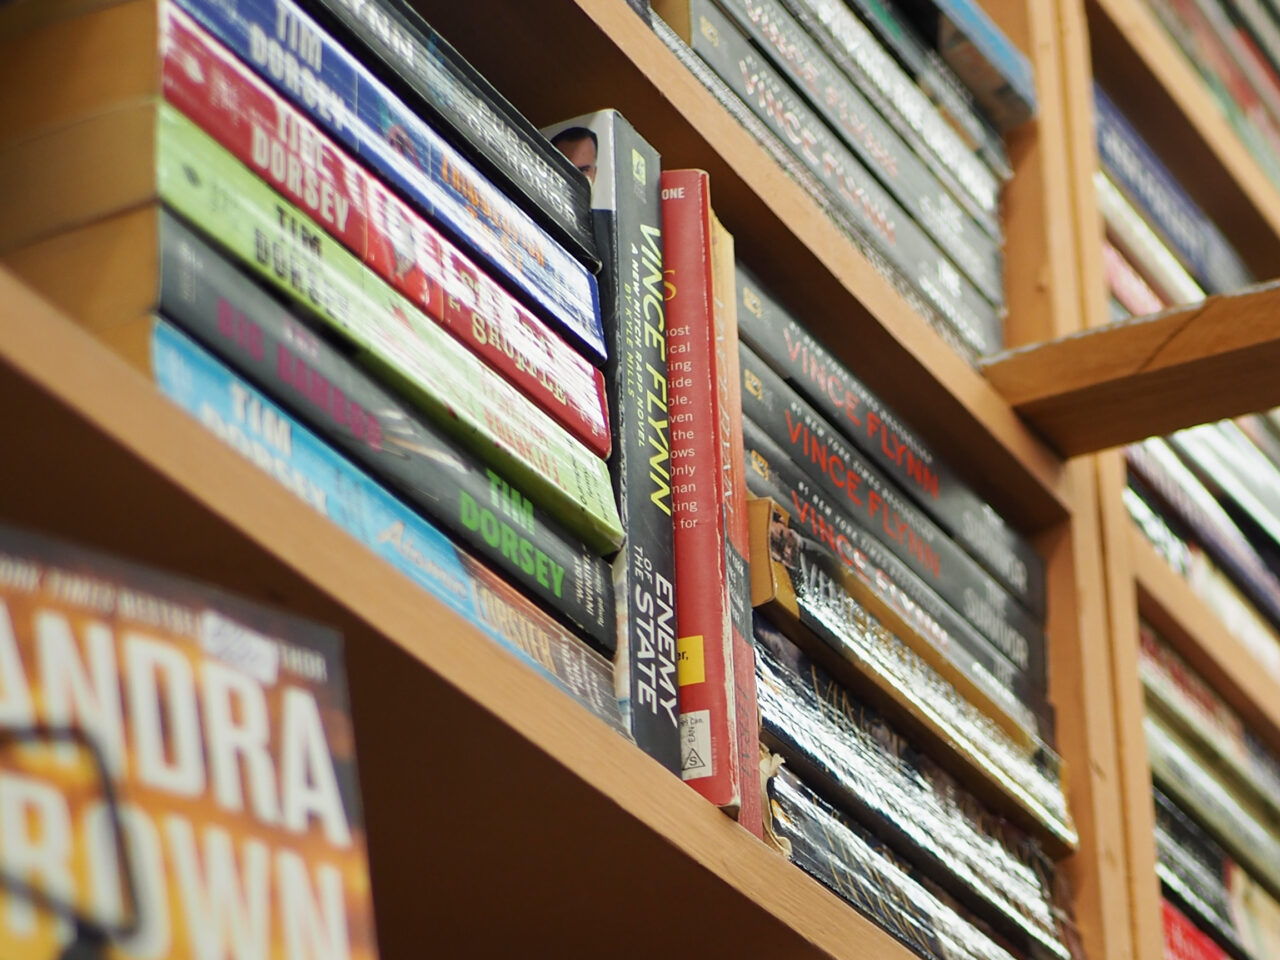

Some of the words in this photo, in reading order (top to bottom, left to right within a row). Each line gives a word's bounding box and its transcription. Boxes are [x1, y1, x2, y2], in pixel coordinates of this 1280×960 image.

[275, 1, 323, 73] TIM
[250, 22, 347, 131] DORSEY
[251, 124, 350, 233] DORSEY
[631, 242, 638, 254] A
[624, 283, 632, 303] BY
[632, 258, 640, 297] NEW
[640, 223, 666, 362] VINCE
[625, 308, 634, 349] KYLE
[634, 299, 642, 348] MITCH
[471, 311, 569, 408] SHUFFLE
[627, 352, 635, 398] MILLS
[635, 350, 643, 393] RAPP
[667, 361, 692, 373] ing
[231, 380, 293, 458] TIM
[637, 396, 645, 447] NOVEL
[673, 429, 695, 441] the
[784, 327, 862, 427] VINCE
[867, 411, 940, 500] FLYNN
[805, 415, 826, 438] NEW
[827, 437, 850, 462] YORK
[645, 362, 672, 517] FLYNN
[486, 467, 536, 536] TIM
[785, 409, 863, 507] VINCE
[868, 491, 941, 580] FLYNN
[812, 494, 832, 517] NEW
[835, 514, 858, 541] YORK
[459, 489, 567, 600] DORSEY
[680, 518, 698, 529] for
[791, 488, 872, 584] VINCE
[634, 545, 645, 581] THE
[643, 556, 653, 586] OF
[635, 589, 658, 716] STATE
[655, 571, 679, 729] ENEMY
[689, 756, 698, 767] S
